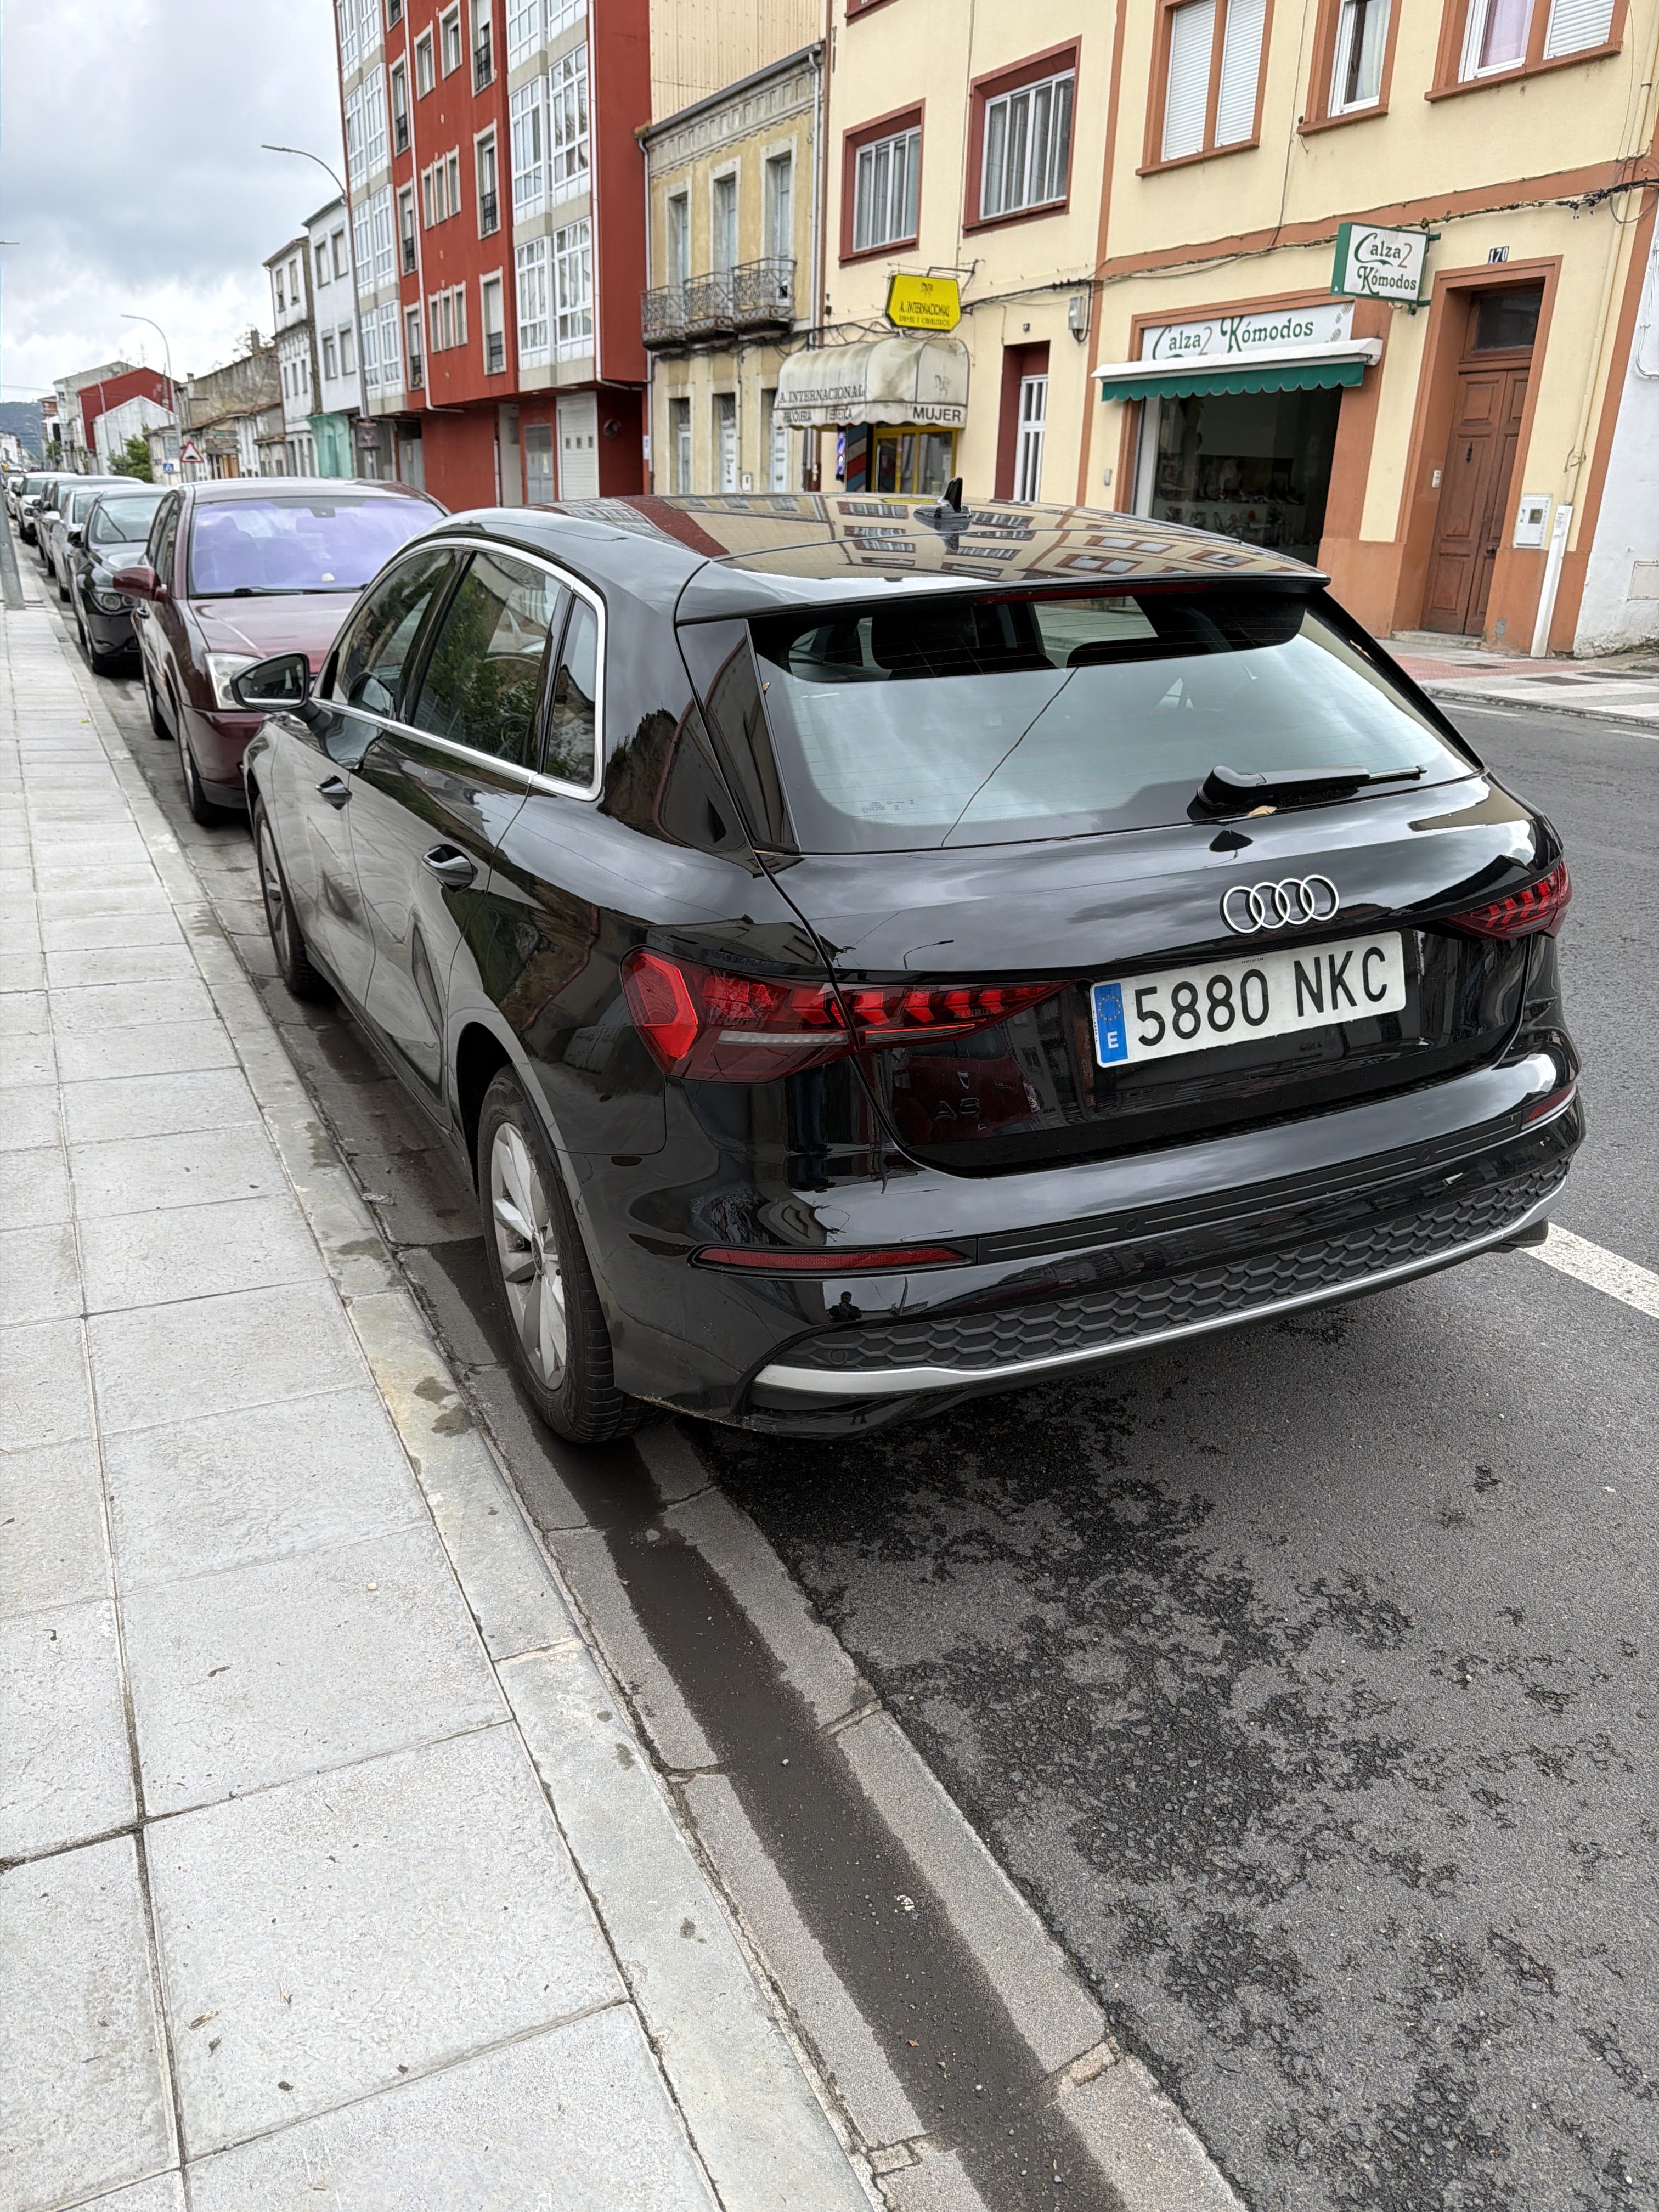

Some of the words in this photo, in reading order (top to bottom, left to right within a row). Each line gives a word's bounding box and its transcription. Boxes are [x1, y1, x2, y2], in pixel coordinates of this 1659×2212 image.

[1488, 247, 1509, 264] 170
[1357, 266, 1417, 295] Kómodos
[1220, 315, 1314, 353] Kómodos
[789, 384, 864, 403] INTERNACIONAL
[913, 406, 961, 422] MUJER
[1135, 969, 1269, 1047] 5880
[1294, 946, 1387, 1018] NKC
[1107, 1031, 1119, 1049] E
